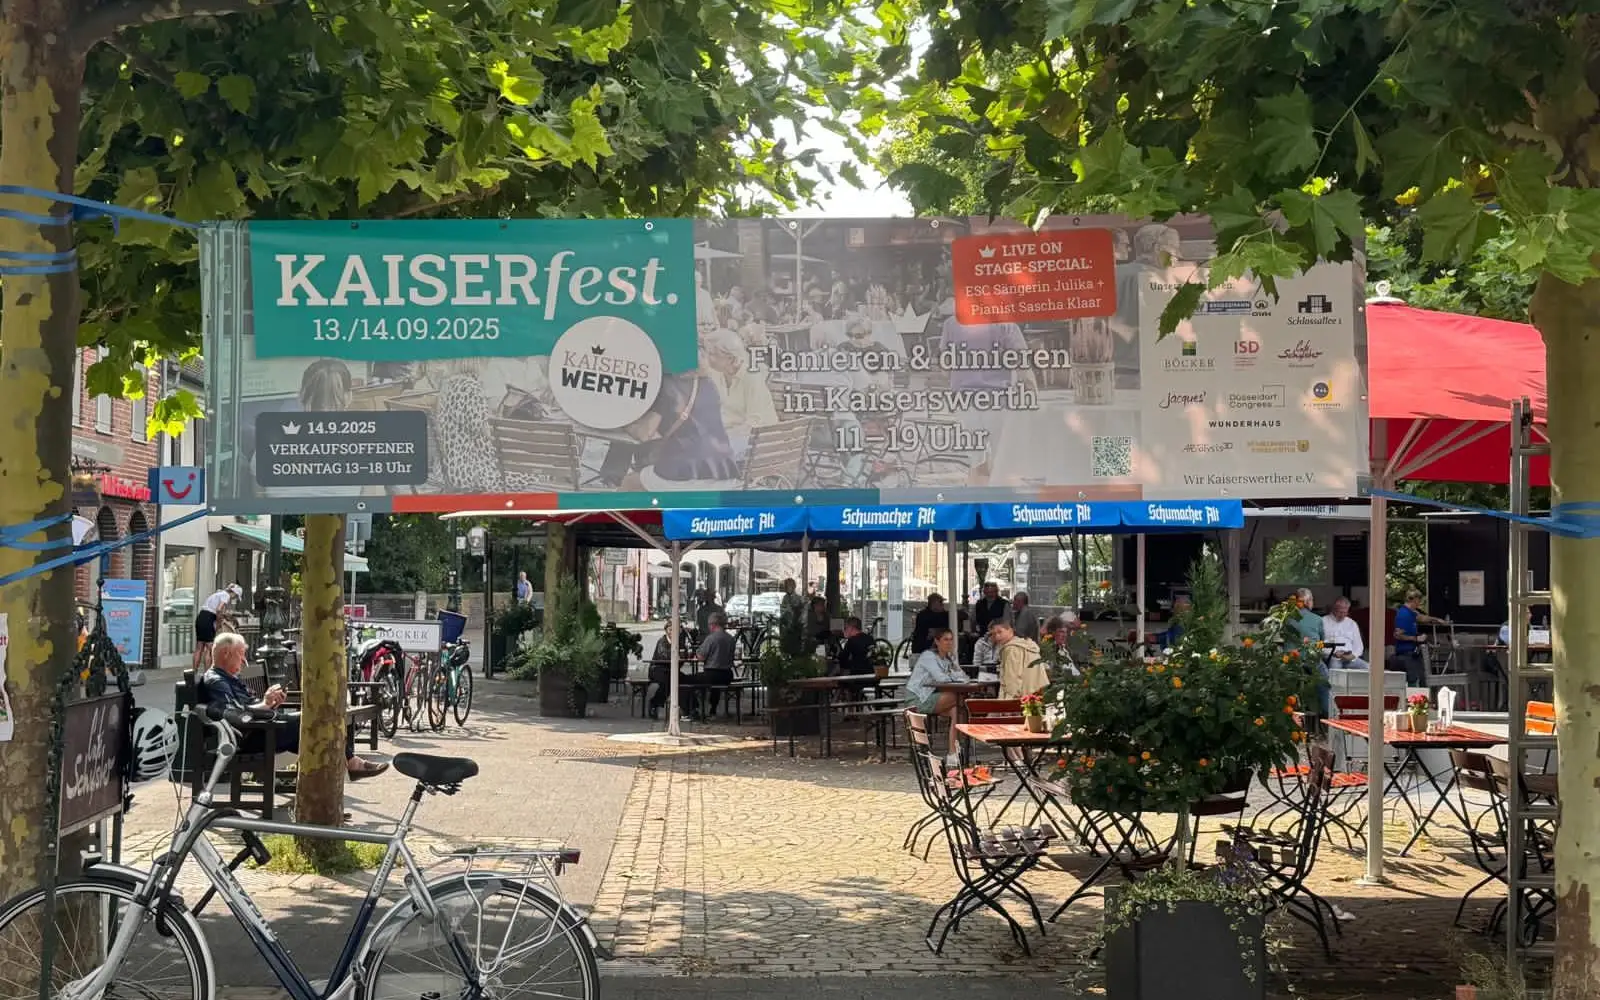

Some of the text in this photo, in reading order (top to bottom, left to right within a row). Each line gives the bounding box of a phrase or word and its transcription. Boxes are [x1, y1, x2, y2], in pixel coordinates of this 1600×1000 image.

[1001, 241, 1063, 257] LIVE ON
[974, 258, 1093, 276] STAGE-SPECIAL:
[965, 285, 991, 297] ESC
[993, 282, 1050, 297] Sängerin
[1054, 278, 1094, 292] Julika
[970, 297, 1103, 316] Pianist Sascha Klaar
[313, 317, 500, 343] 13./14.09.2025
[1233, 340, 1260, 354] ISD
[563, 350, 650, 379] KAISERS
[747, 341, 1073, 373] Flanieren & dinieren
[561, 367, 649, 400] WERTH
[783, 382, 1041, 413] in Kaiserswerth
[1228, 401, 1273, 410] Congress
[307, 421, 377, 435] 14.9.2025
[1208, 420, 1282, 428] WUNDERHAUS
[835, 423, 990, 453] 11–19 Uhr
[269, 442, 415, 456] VERKAUFSOFFENER
[272, 461, 413, 476] SONNTAG 13–18 Uhr
[1183, 473, 1205, 485] Wir
[1207, 471, 1293, 485] Kaiserswerther
[690, 512, 776, 534] Schumacher Alt
[842, 506, 937, 527] Schumacher Alt
[1012, 503, 1092, 525] Schumacher Alt
[1147, 504, 1220, 524] Schumacher Alt
